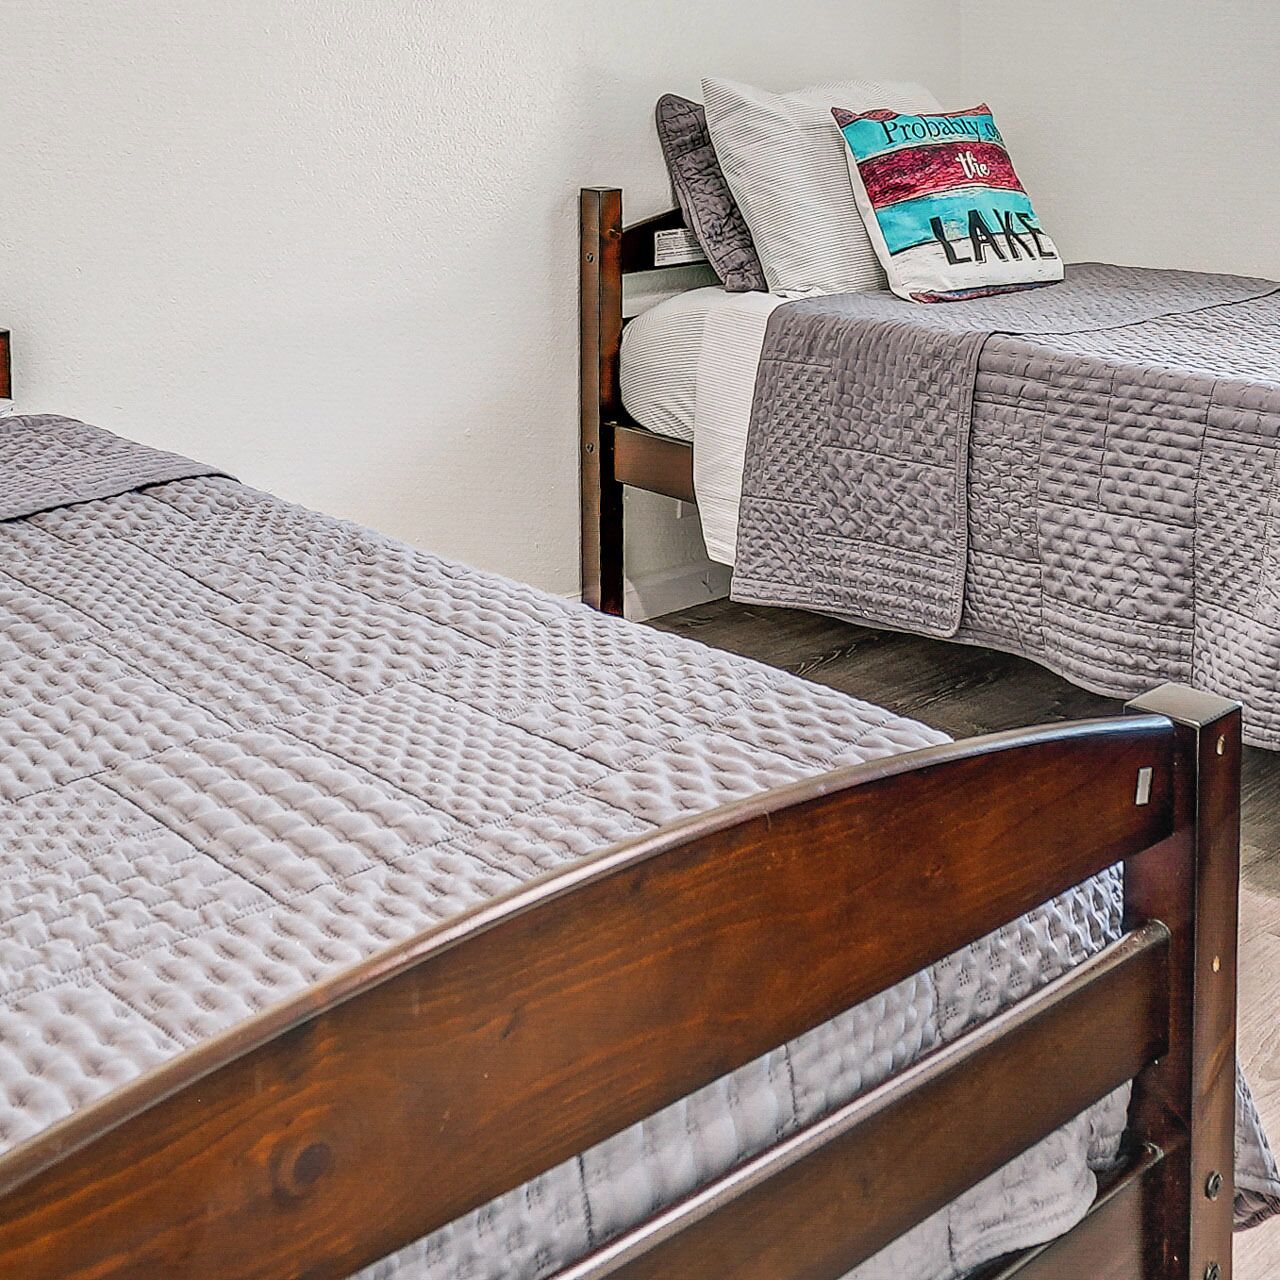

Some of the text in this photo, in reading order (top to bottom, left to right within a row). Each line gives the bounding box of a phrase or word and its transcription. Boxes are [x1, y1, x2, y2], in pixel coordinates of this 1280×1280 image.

[880, 117, 981, 144] Probably
[956, 150, 991, 179] the
[930, 209, 1057, 264] LAKE
